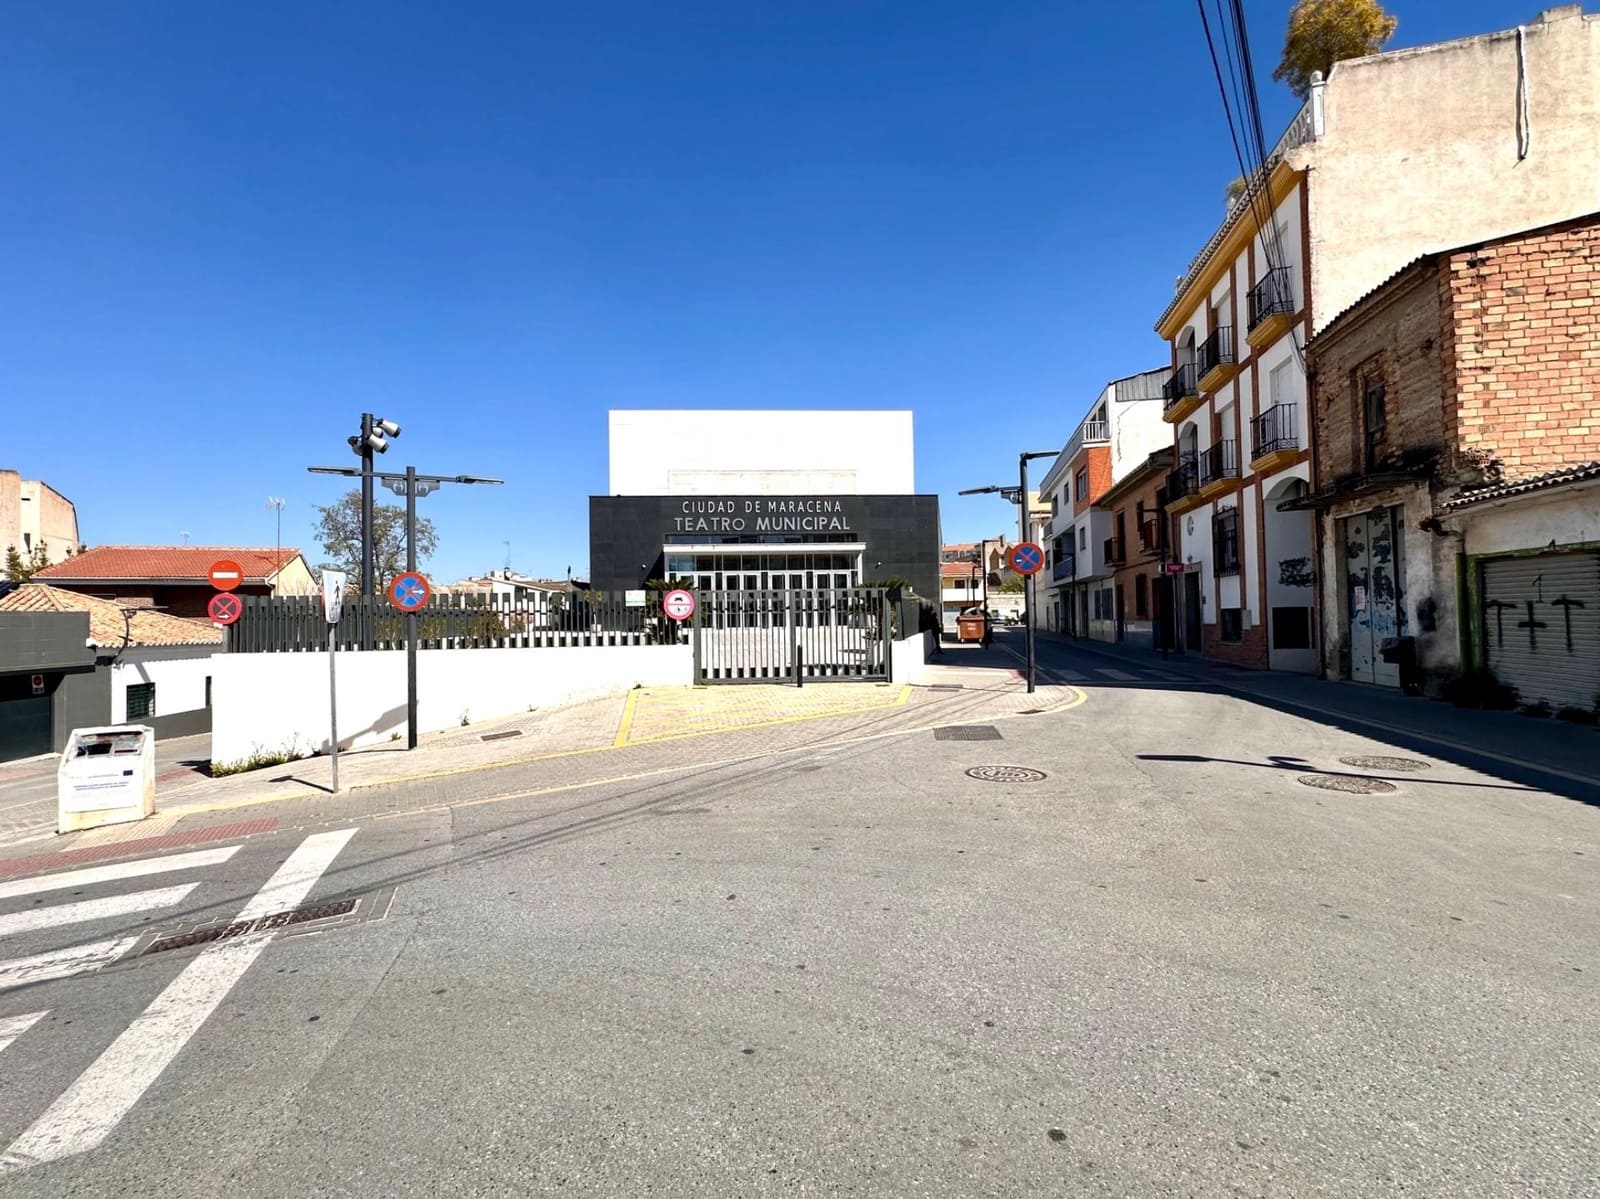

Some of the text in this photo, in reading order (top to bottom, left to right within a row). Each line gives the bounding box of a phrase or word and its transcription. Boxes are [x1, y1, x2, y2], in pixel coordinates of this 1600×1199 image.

[682, 500, 842, 513] CIUDAD DE MARACENA
[674, 516, 851, 531] TEATRO MUNICIPAL
